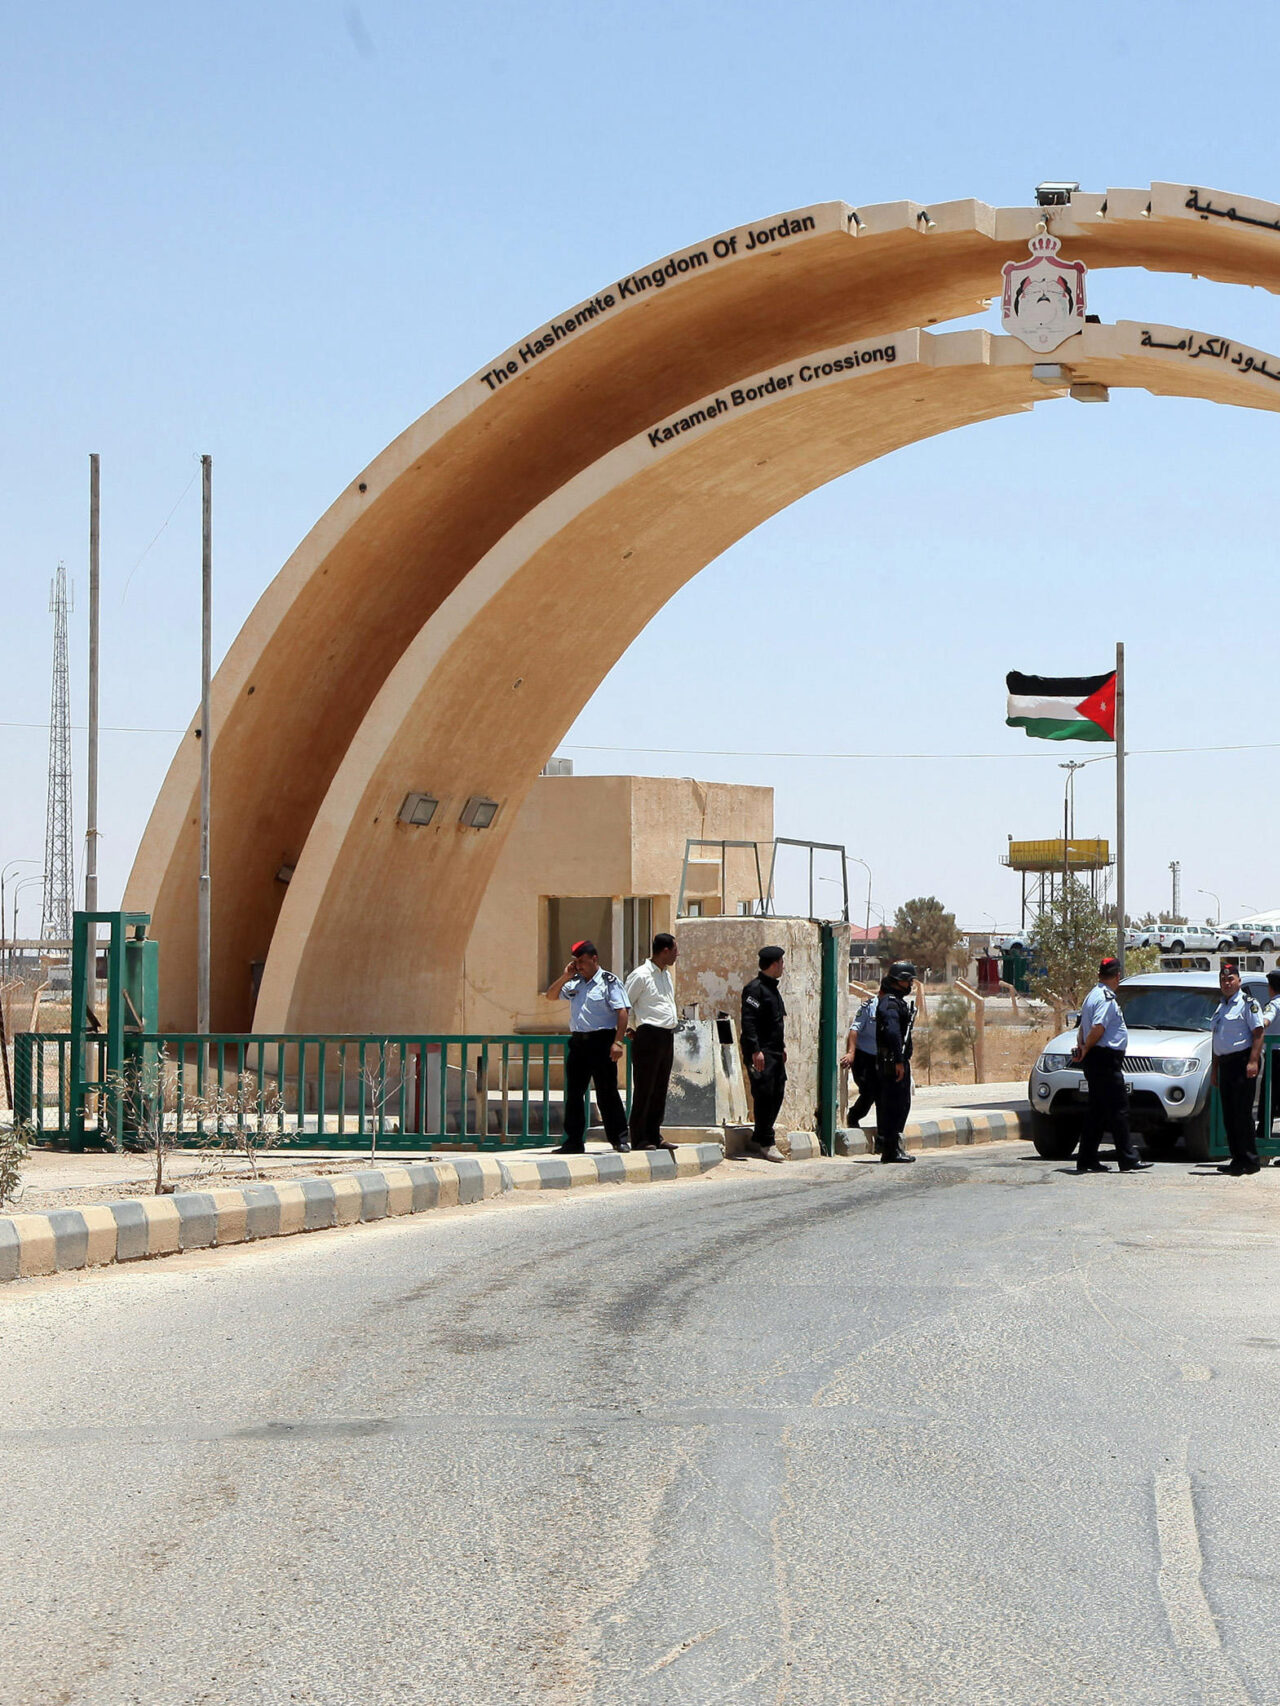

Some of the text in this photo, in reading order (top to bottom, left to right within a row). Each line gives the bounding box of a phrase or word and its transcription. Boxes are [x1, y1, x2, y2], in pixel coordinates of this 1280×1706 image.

[480, 215, 816, 390] The Hashemite Kingdom Of Jordan
[1141, 331, 1230, 358] الكرامة
[647, 344, 897, 447] Karameh Border Crossiong
